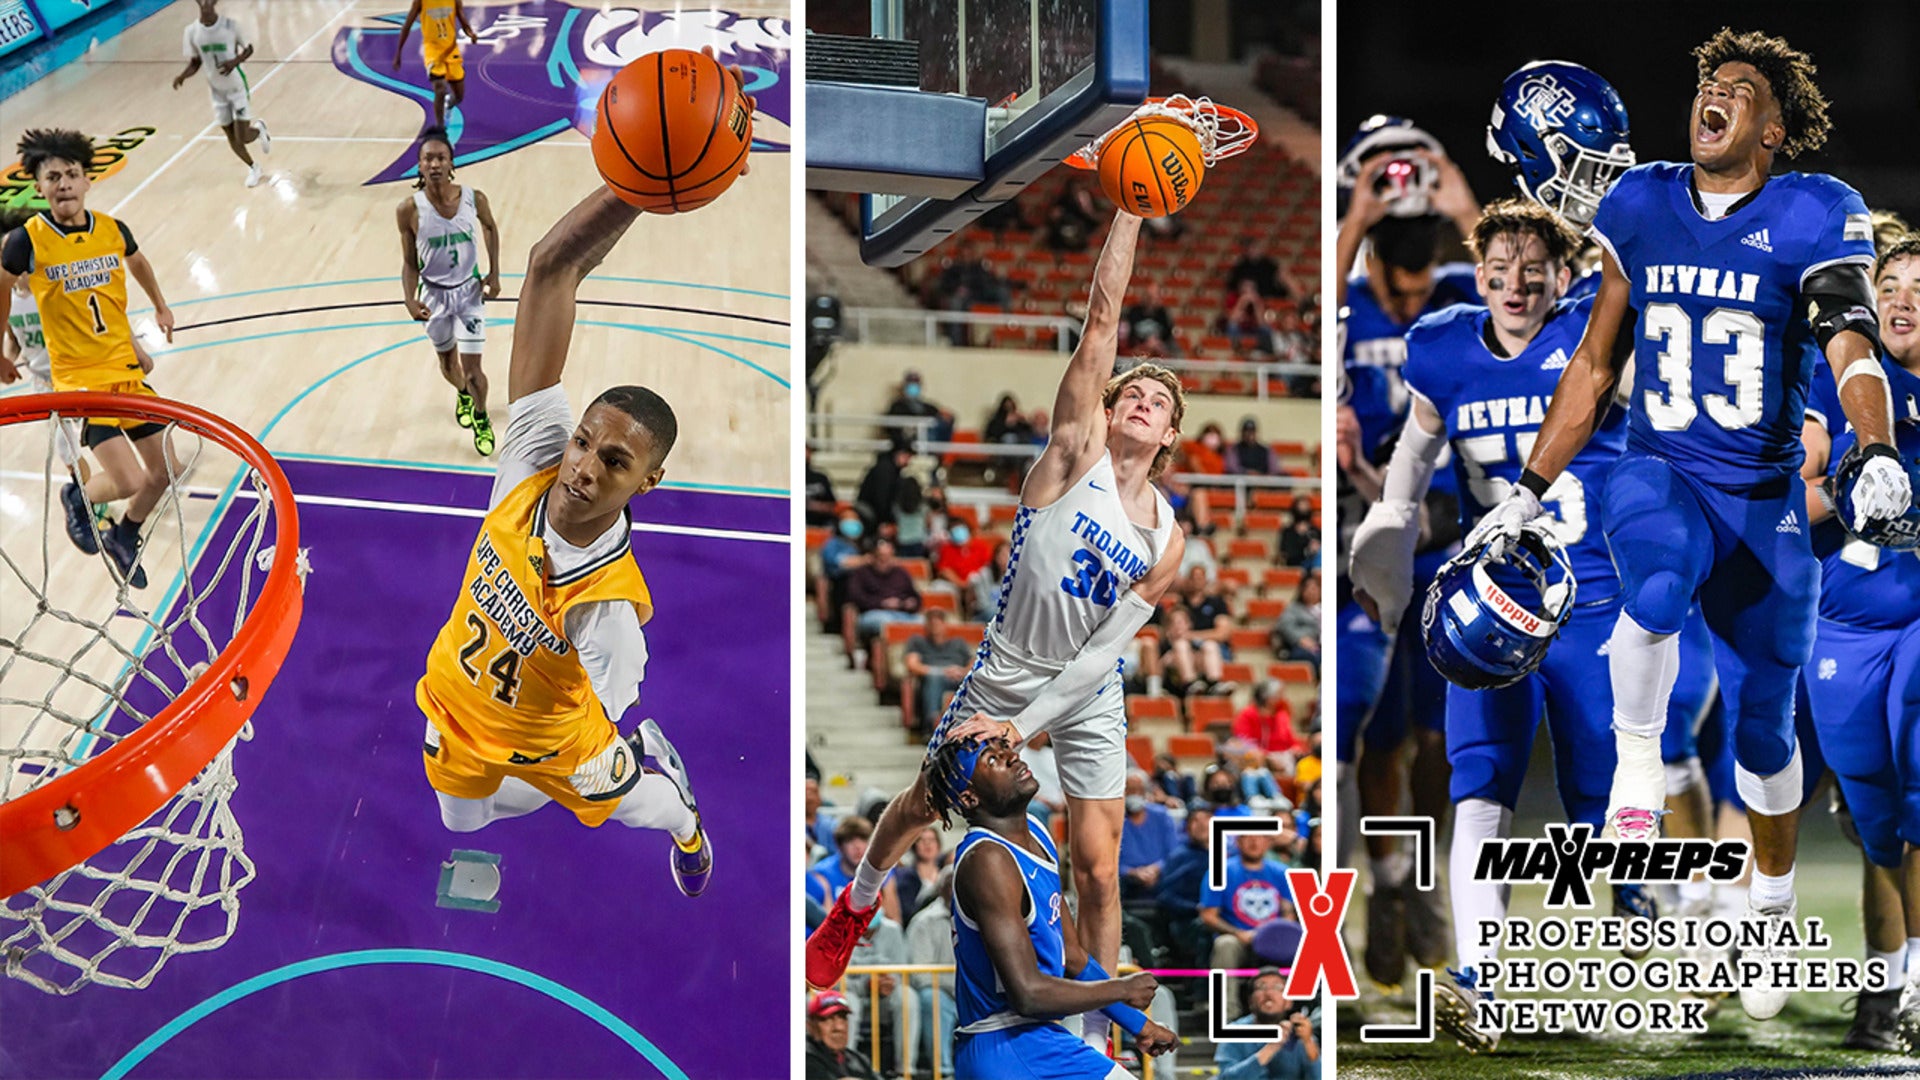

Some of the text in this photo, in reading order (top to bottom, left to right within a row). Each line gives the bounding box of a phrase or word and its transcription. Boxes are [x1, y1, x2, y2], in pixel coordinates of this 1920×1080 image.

[63, 271, 111, 293] ACADEMY
[70, 254, 120, 276] CHRISTIAN
[1645, 265, 1760, 302] NEWMAN
[87, 293, 107, 334] 1
[1644, 302, 1765, 432] 33
[1457, 395, 1555, 431] NEWMA
[1060, 548, 1119, 610] 30
[469, 575, 539, 657] ACADEMY
[494, 568, 570, 656] CHRISTIAN
[1485, 584, 1541, 633] Riddell
[460, 610, 524, 707] 24
